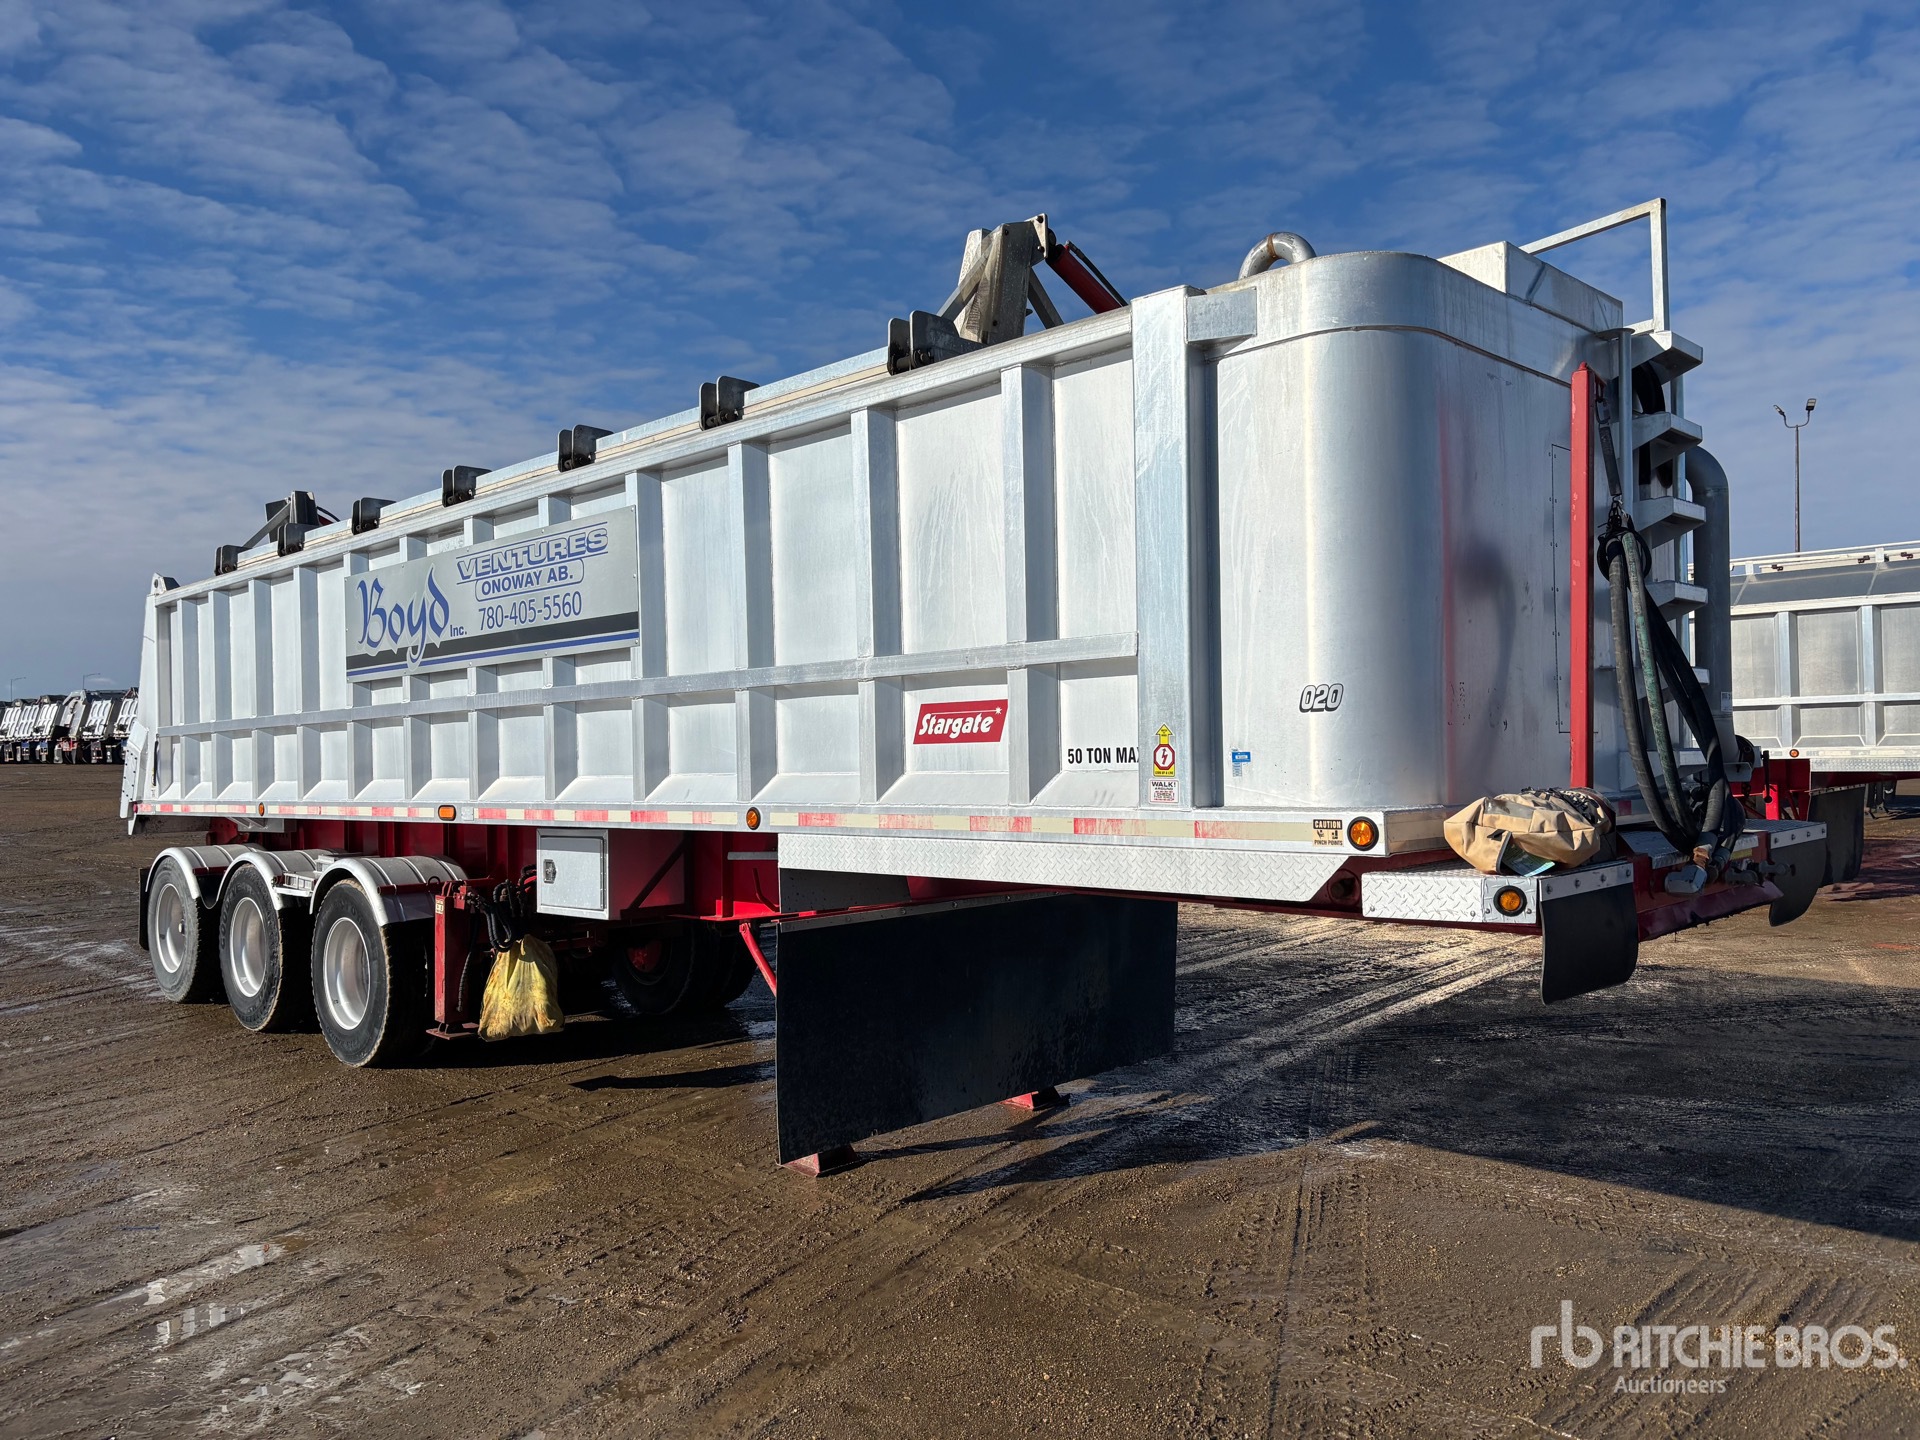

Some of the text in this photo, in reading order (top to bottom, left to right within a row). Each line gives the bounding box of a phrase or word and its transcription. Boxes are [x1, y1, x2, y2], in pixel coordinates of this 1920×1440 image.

[457, 528, 608, 580] VENTURES
[481, 565, 574, 596] ONOWAY AB.
[356, 565, 468, 665] Boyd Inc.
[478, 590, 582, 631] 780-405-5560
[1299, 683, 1344, 713] 020
[918, 713, 994, 739] Stargate
[1067, 748, 1083, 764] 50
[1086, 747, 1111, 764] TON
[1314, 820, 1341, 829] CAUTION
